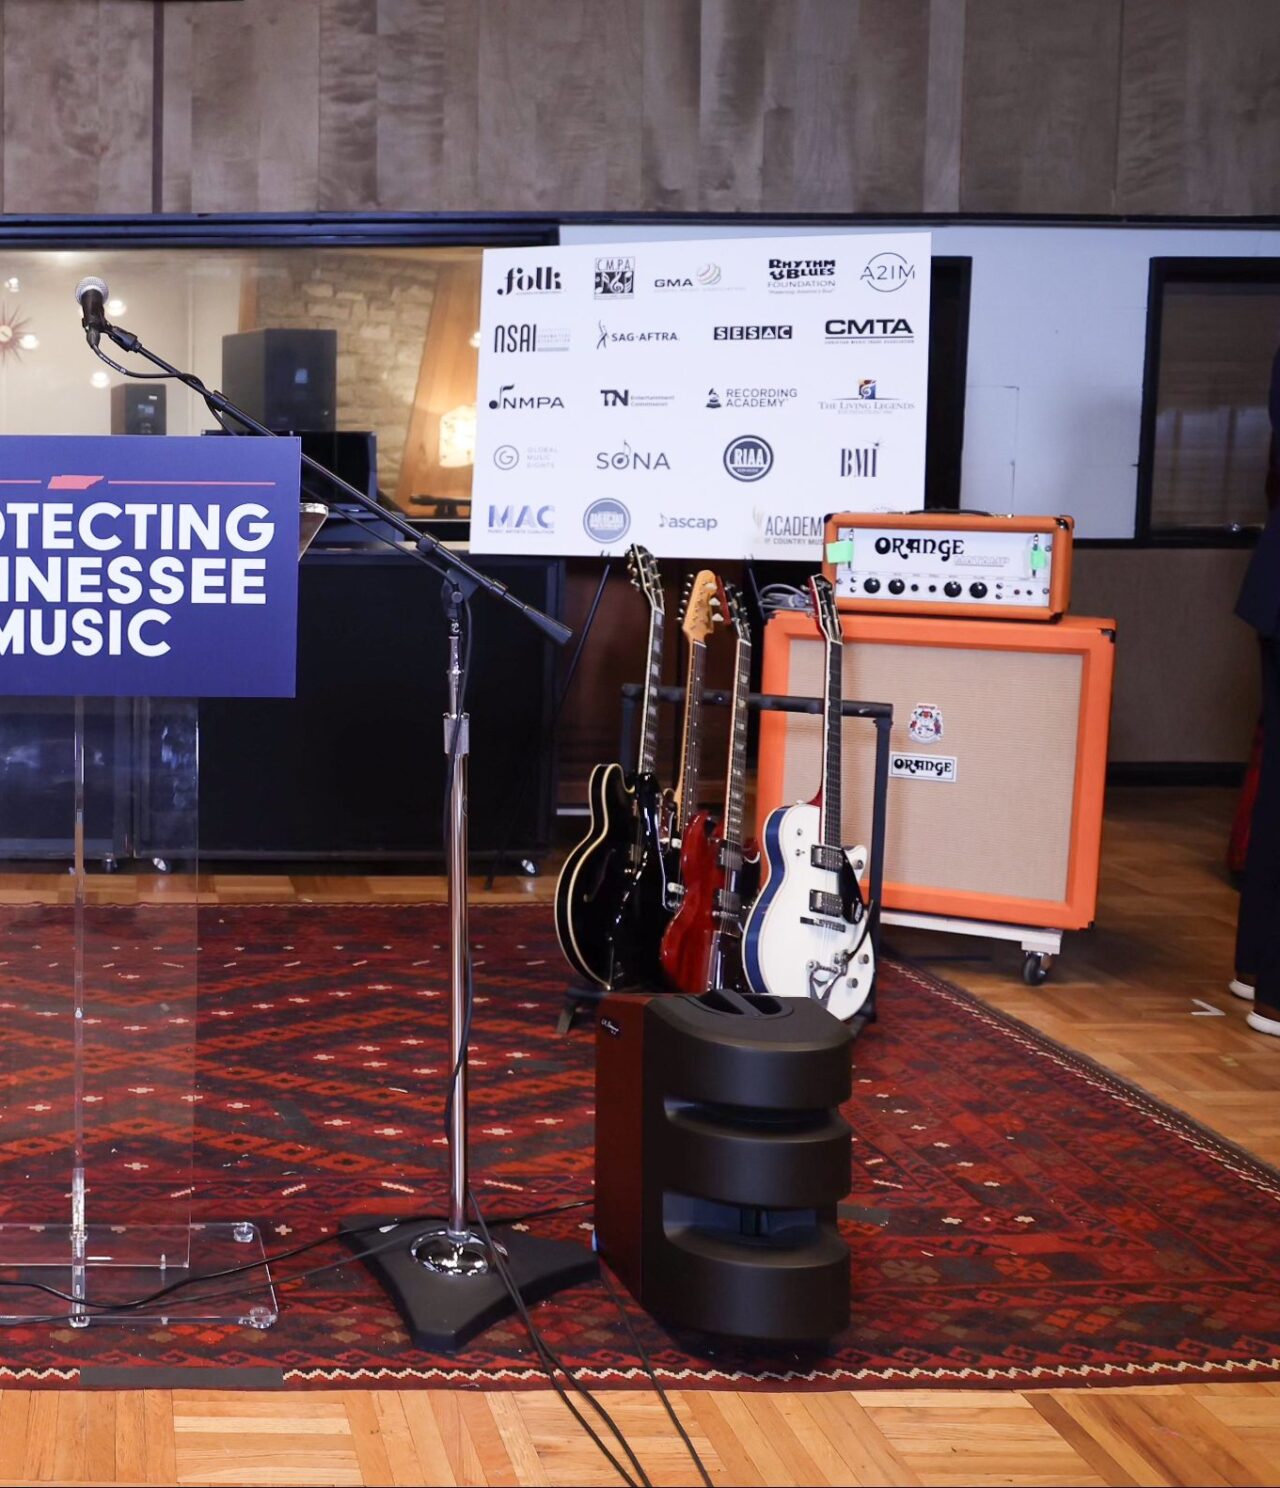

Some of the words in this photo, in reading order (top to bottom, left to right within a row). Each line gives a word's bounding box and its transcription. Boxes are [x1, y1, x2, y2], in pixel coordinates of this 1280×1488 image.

[769, 259, 836, 269] RHYTHM
[786, 268, 835, 280] BLUES
[860, 264, 915, 281] A2IM
[654, 278, 694, 288] GMA
[768, 280, 836, 288] FOUNDATION
[714, 325, 793, 340] SESAC
[825, 319, 913, 335] CMTA
[494, 324, 537, 353] NSAI
[600, 389, 629, 407] TN
[726, 388, 798, 398] RECORDING
[503, 397, 565, 409] NMPA
[726, 398, 785, 408] ACADEMY
[596, 452, 671, 470] SONA
[734, 448, 765, 465] RIAA
[840, 448, 877, 477] BMI
[488, 505, 556, 528] MAC
[668, 515, 718, 531] ascap
[765, 516, 822, 537] ACADEM
[875, 537, 964, 562] ORANGE
[894, 758, 952, 776] ORANGE
